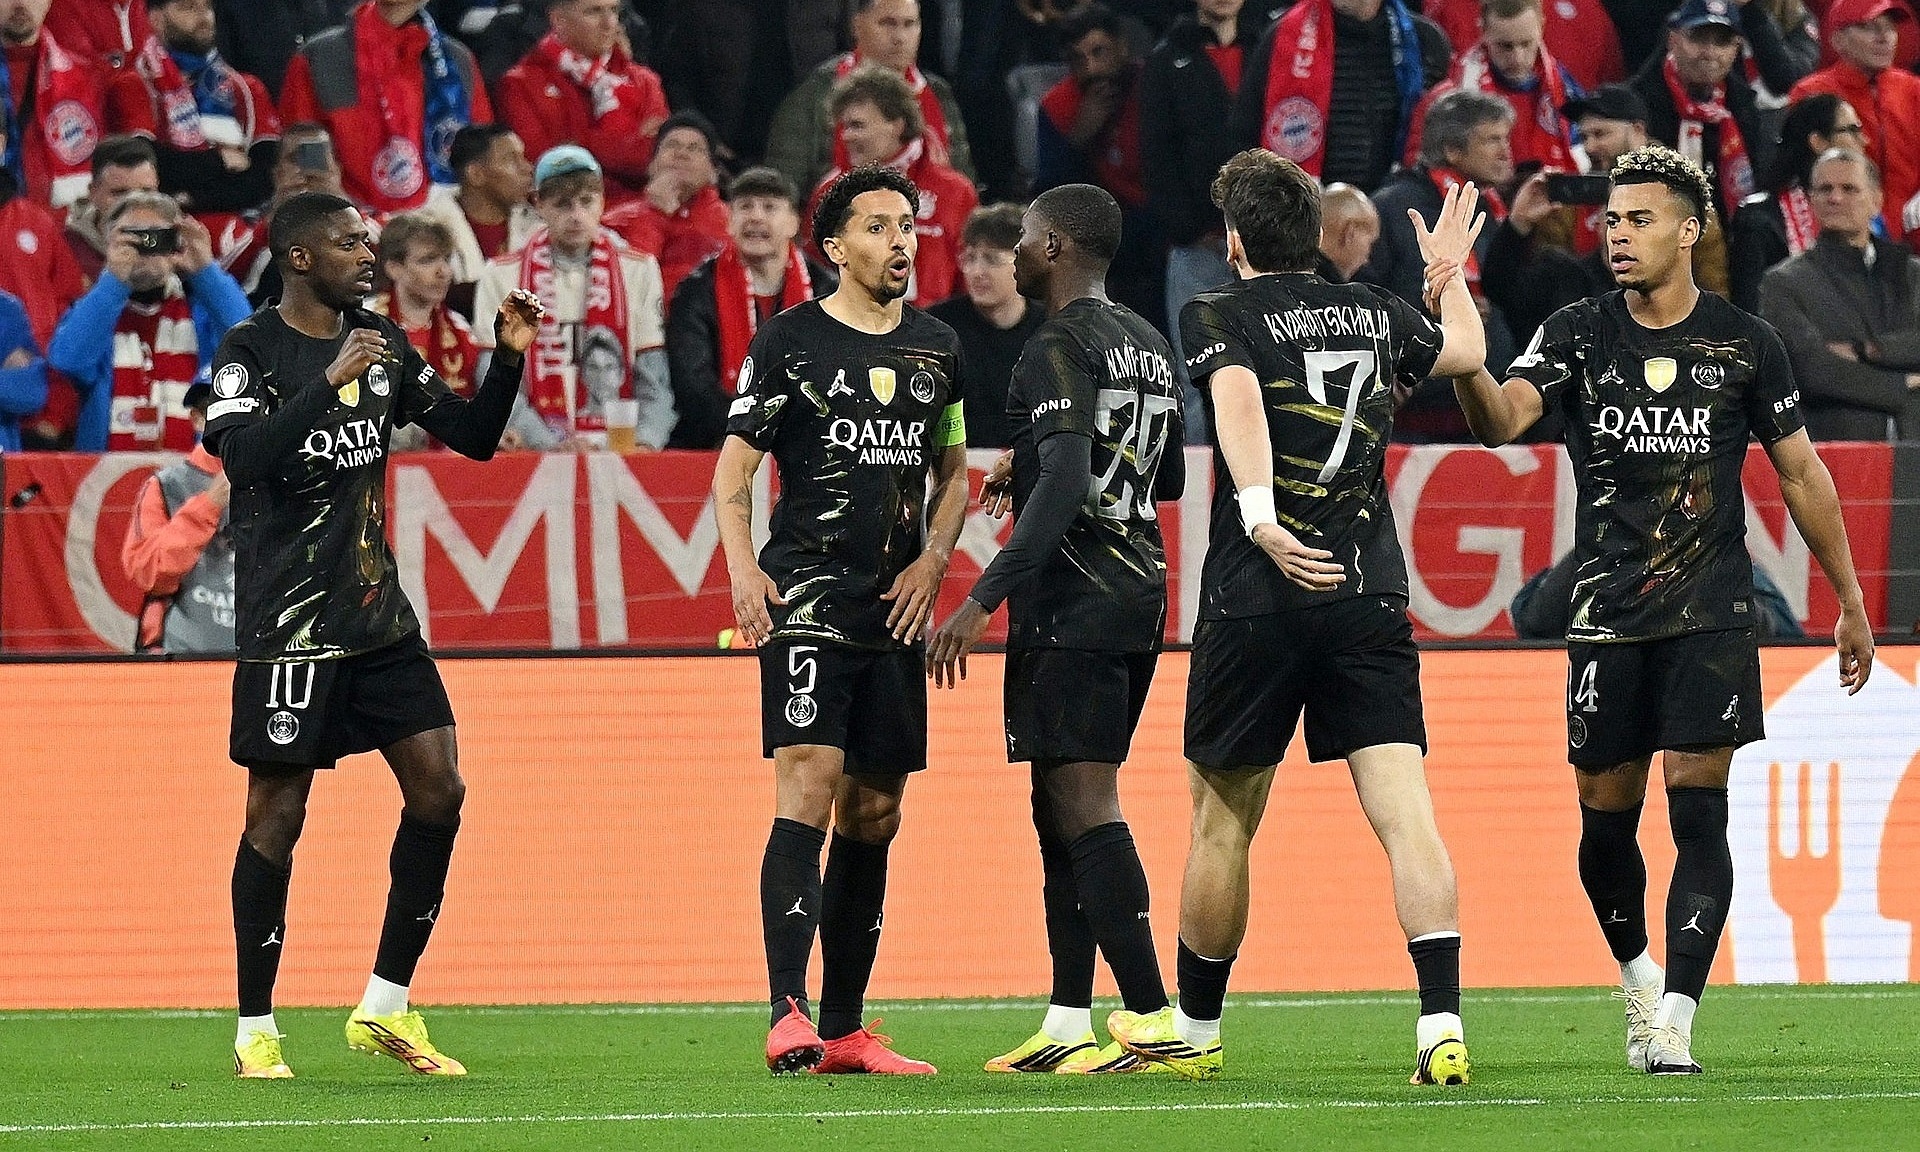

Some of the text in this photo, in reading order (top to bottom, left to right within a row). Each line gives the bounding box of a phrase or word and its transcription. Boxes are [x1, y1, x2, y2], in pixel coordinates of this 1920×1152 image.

[1031, 398, 1072, 423] YOND
[1303, 350, 1375, 484] 7
[1599, 406, 1711, 440] QATAR
[829, 418, 925, 451] QATAR
[1624, 436, 1711, 454] AIRWAYS
[858, 449, 922, 466] AIRWAYS
[265, 661, 315, 709] 10
[788, 646, 818, 694] 5
